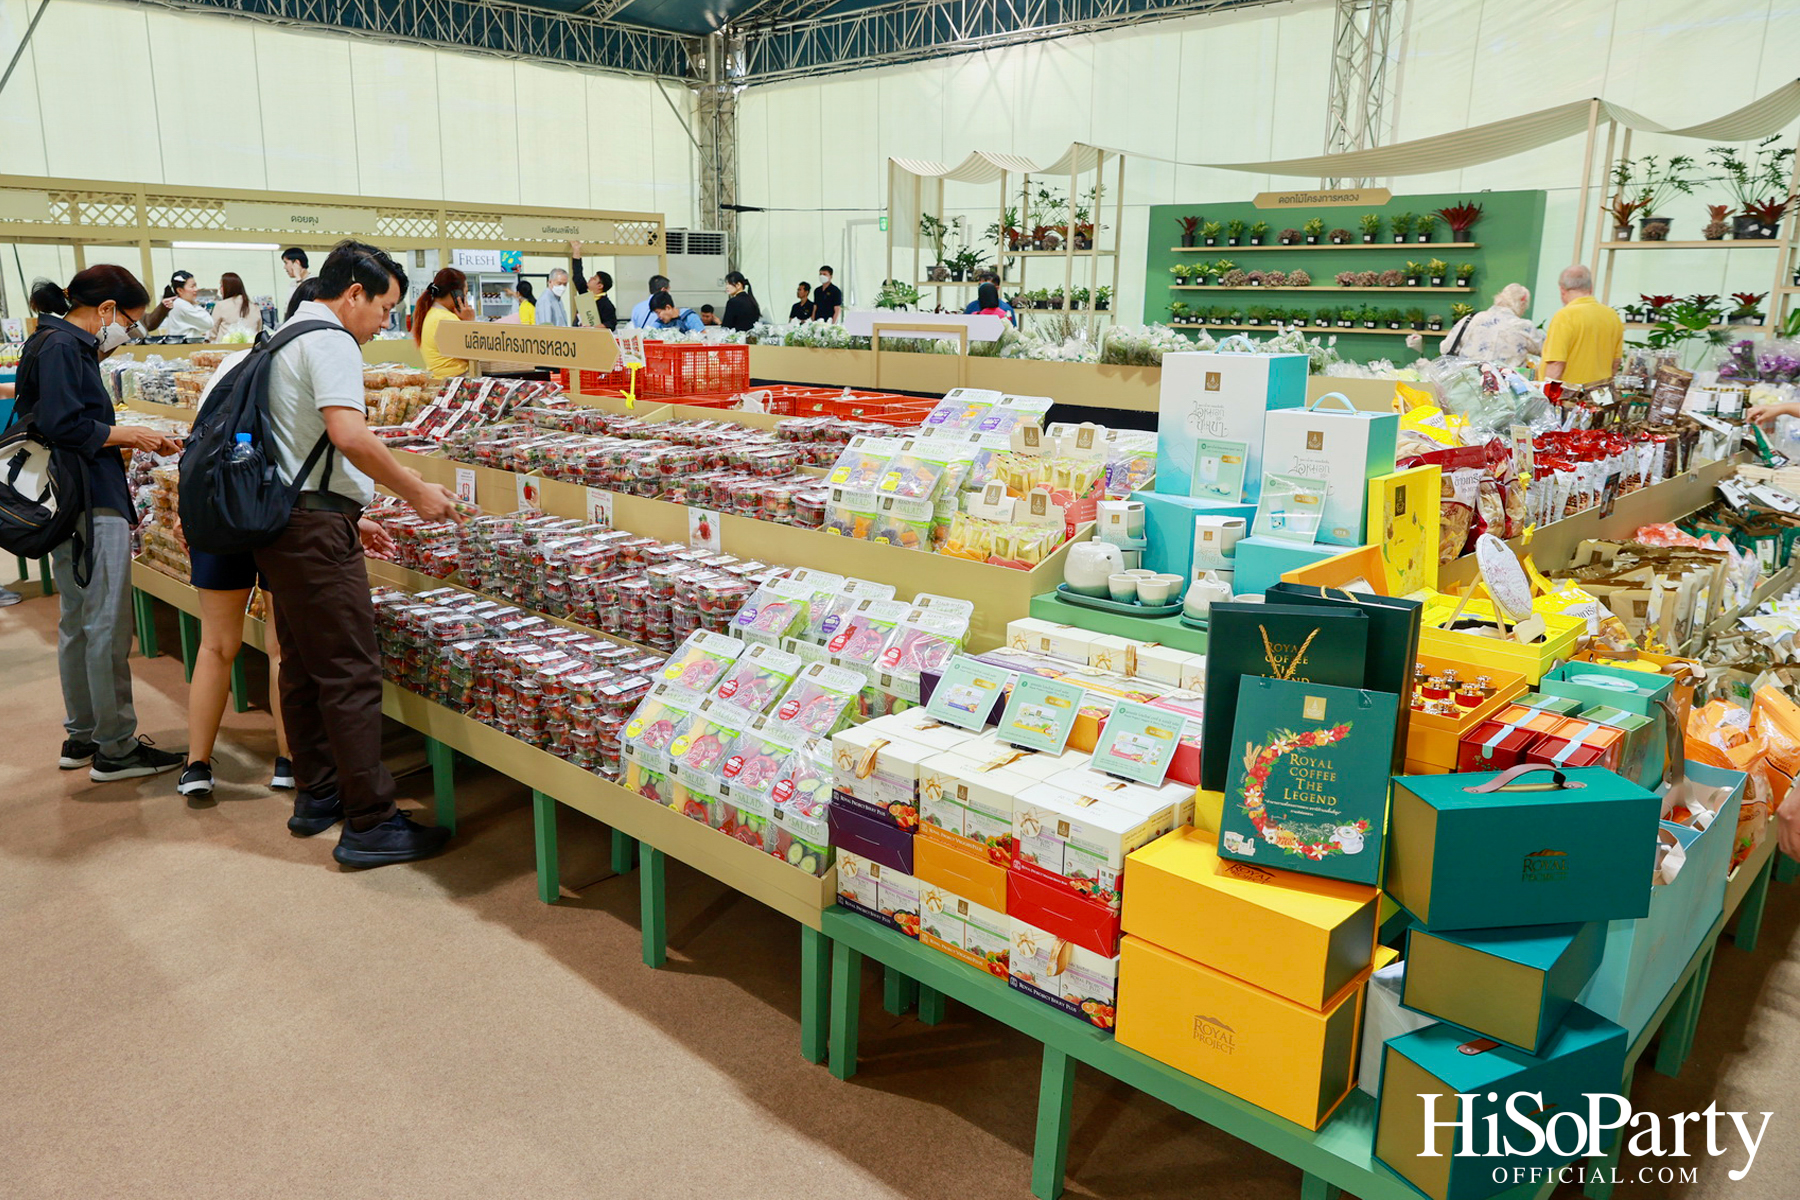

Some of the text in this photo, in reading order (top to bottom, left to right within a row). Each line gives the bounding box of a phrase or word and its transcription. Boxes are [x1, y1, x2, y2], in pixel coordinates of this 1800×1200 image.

[1278, 192, 1360, 204] ดอกไม้โครงการหลวง
[290, 215, 319, 226] ดอยตุง
[458, 253, 495, 266] FRESH
[464, 330, 576, 358] ผลิตผลโครงการหลวง
[847, 497, 869, 505] SALAD
[899, 506, 921, 515] SALAD
[827, 674, 852, 686] SALAD
[768, 728, 796, 742] SALAD
[640, 752, 659, 766] SALAD
[1289, 753, 1334, 770] ROYAL
[685, 771, 704, 786] SALAD
[1289, 767, 1337, 782] COFFEE
[1295, 778, 1323, 792] THE
[737, 793, 761, 808] SALAD
[1283, 787, 1338, 806] LEGEND
[841, 796, 886, 817] ROYAL PROJECT BERRY PLUS
[791, 818, 817, 835] SALAD
[929, 827, 940, 836] ROYAL
[941, 832, 955, 842] PROJECT
[1231, 864, 1271, 882] ROYAL
[1523, 859, 1569, 873] ROYAL
[845, 900, 856, 909] ROYAL
[856, 905, 871, 915] PROJECT
[871, 911, 881, 920] BERRY
[930, 938, 941, 946] ROYAL
[941, 942, 956, 953] PROJECT
[972, 957, 983, 966] PLUS
[1019, 982, 1077, 1013] ROYAL PROJECT BERRY PLUS
[1194, 1017, 1235, 1046] ROYAL
[1193, 1031, 1235, 1055] PROJECT
